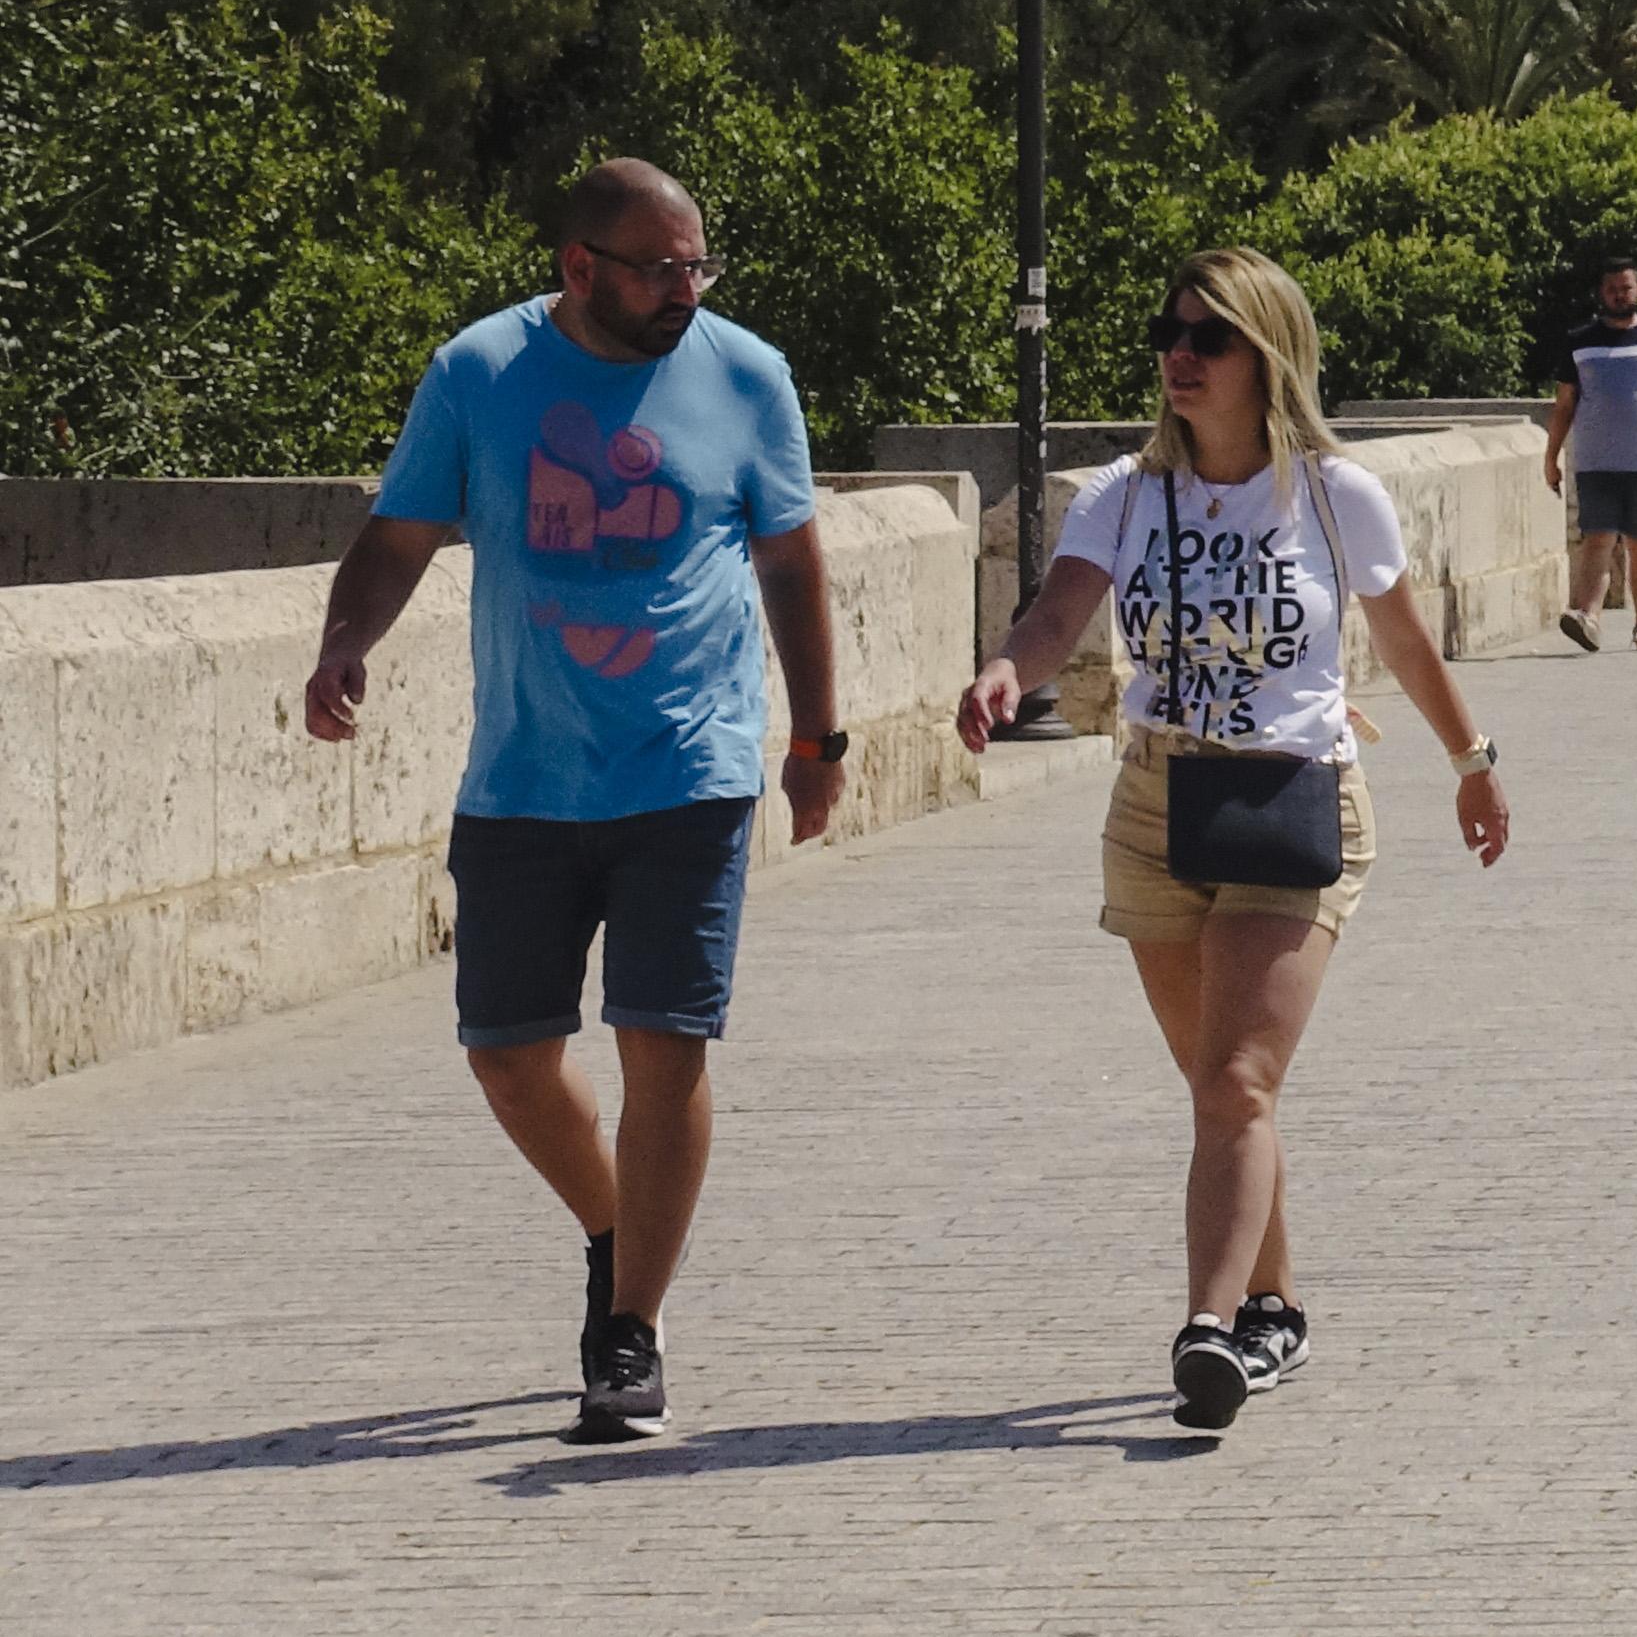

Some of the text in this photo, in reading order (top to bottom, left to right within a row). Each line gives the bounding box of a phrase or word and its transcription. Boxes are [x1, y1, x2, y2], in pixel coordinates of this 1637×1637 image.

[1144, 527, 1280, 565] LOOK
[1124, 560, 1297, 599] AT THE
[1119, 597, 1305, 638] WORLD
